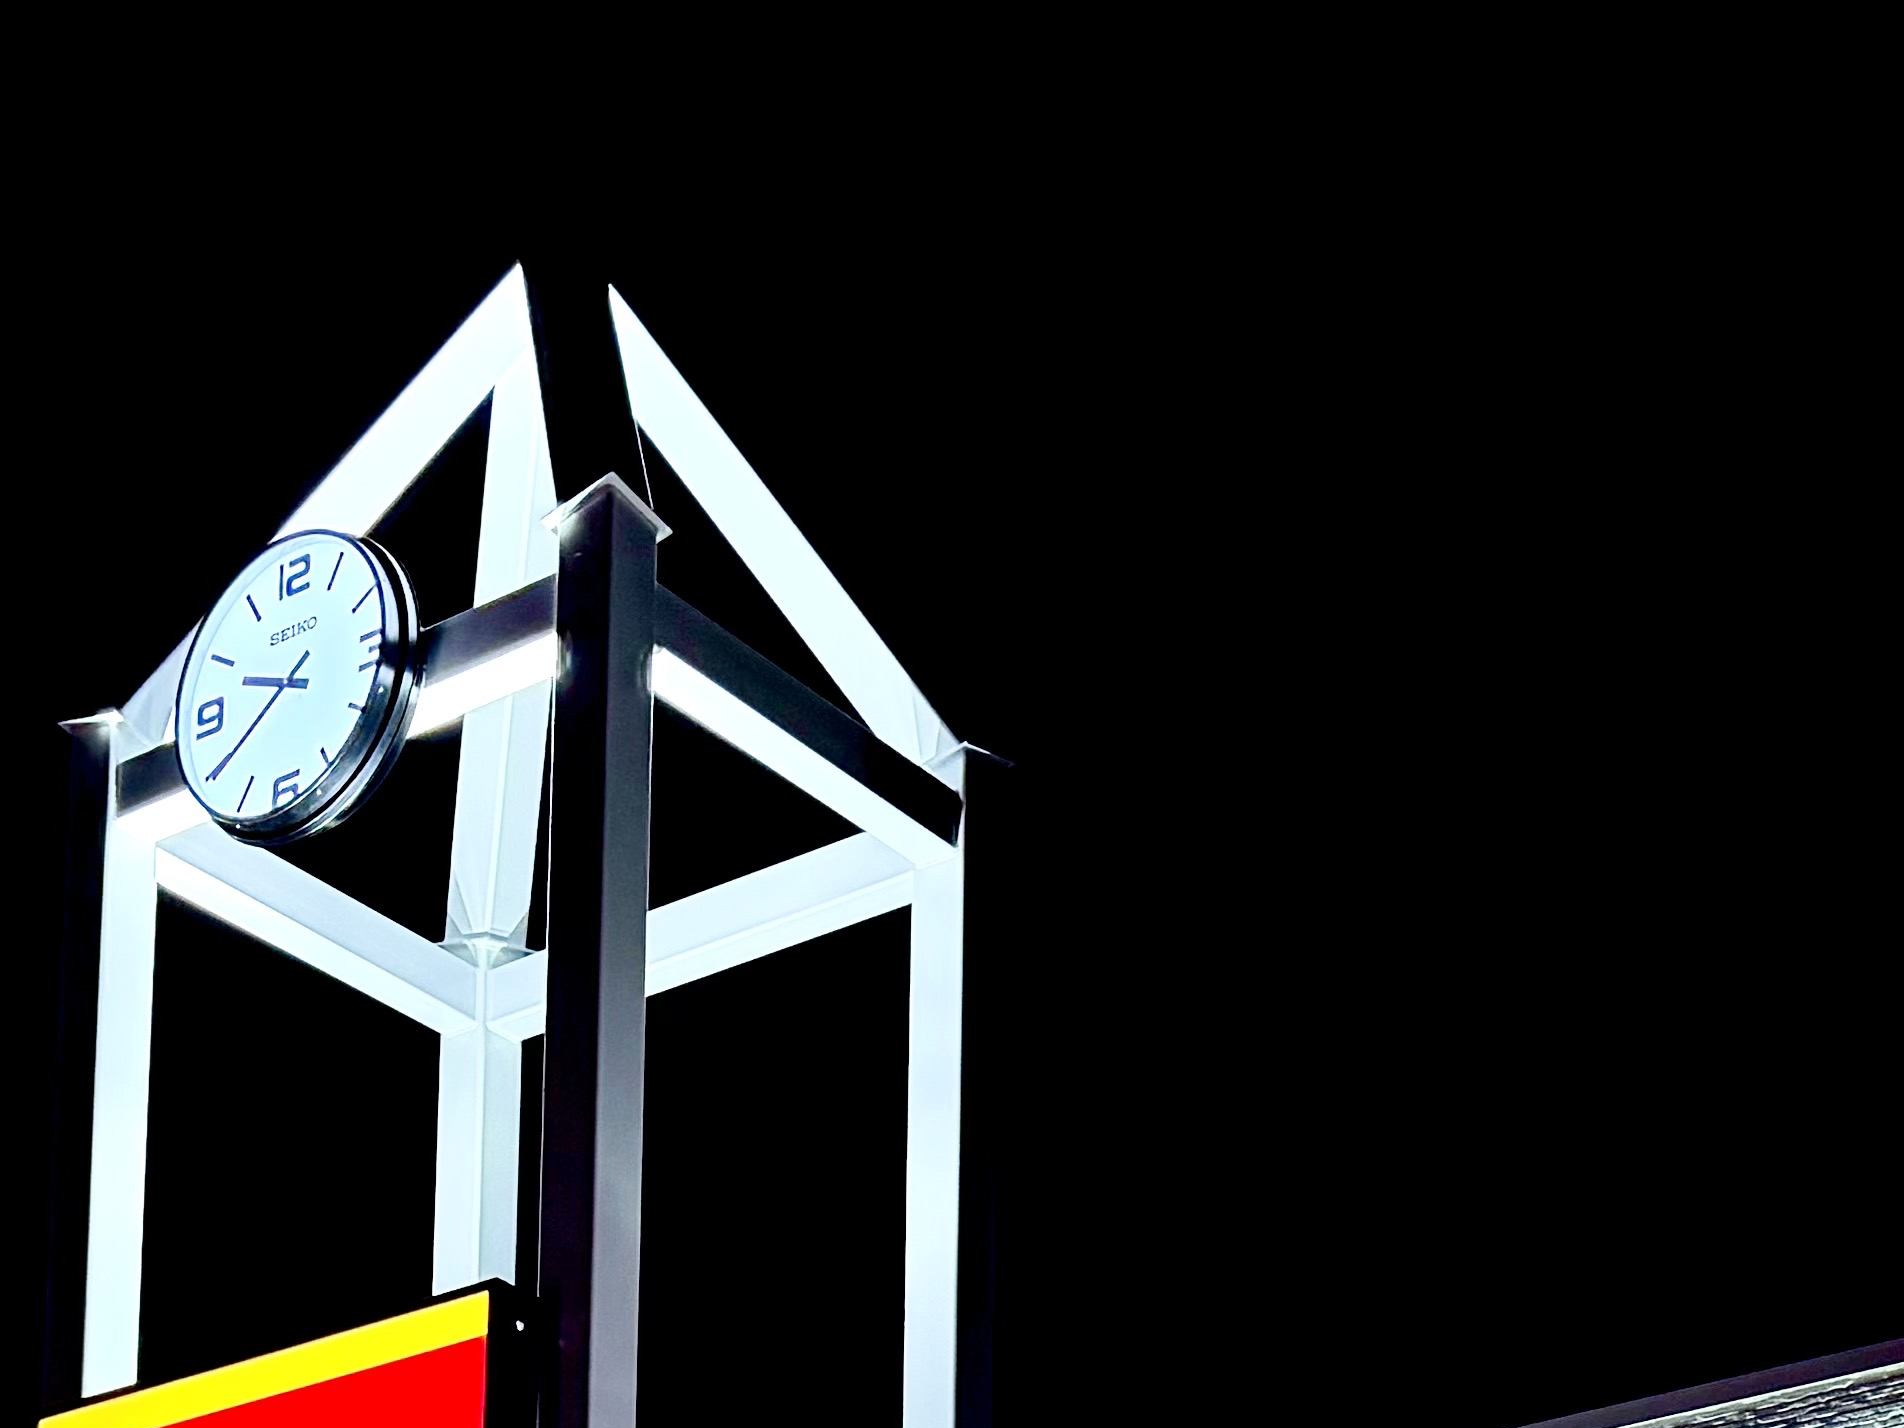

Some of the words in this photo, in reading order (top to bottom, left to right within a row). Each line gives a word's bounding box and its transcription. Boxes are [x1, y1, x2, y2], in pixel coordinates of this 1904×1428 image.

[278, 553, 311, 601] 12
[270, 616, 317, 646] SEIKO
[196, 696, 225, 740] 9
